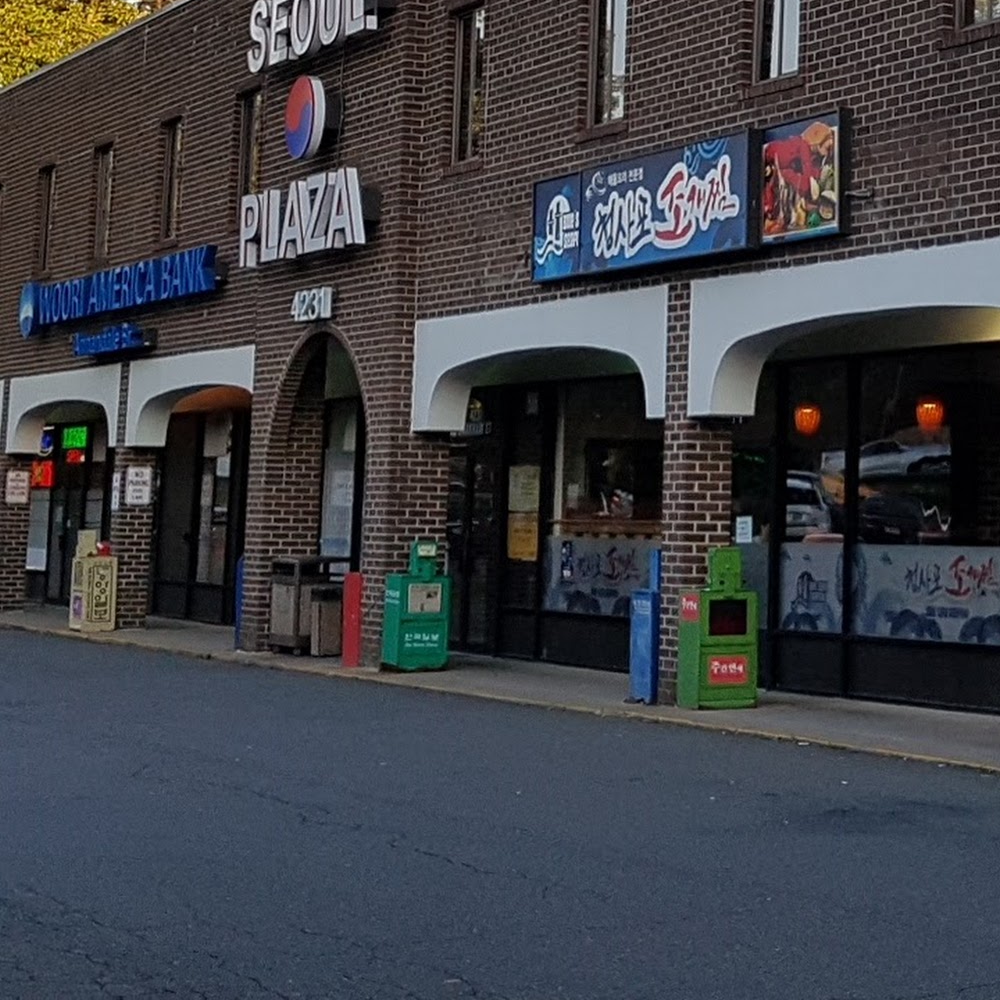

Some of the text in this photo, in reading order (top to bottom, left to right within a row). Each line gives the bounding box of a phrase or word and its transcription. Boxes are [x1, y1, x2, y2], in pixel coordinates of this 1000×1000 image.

[239, 167, 366, 267] PLAZA
[38, 246, 208, 325] WOORI AMERICA BANK
[290, 286, 331, 322] 4231
